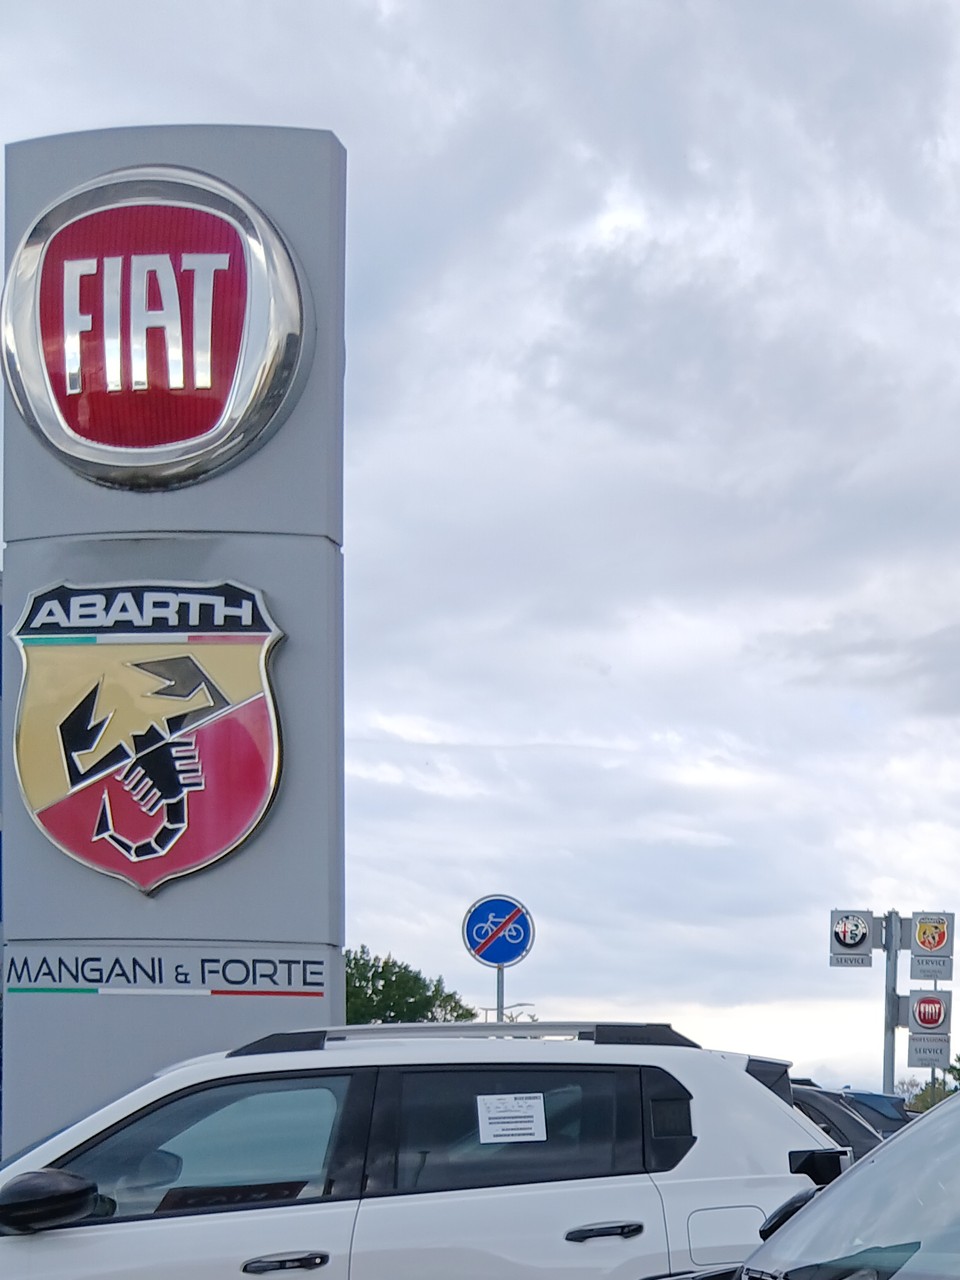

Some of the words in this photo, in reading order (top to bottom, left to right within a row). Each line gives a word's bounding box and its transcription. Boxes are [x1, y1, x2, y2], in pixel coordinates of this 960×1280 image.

[62, 251, 231, 396] FIAT
[29, 591, 254, 632] ABARTH
[835, 957, 865, 965] SERVICE
[916, 959, 947, 967] SERVICE
[6, 955, 166, 986] MANGANI
[174, 962, 192, 986] &
[200, 958, 326, 988] FORTE
[919, 1003, 941, 1020] FIAT
[914, 1047, 944, 1055] SERVICE
